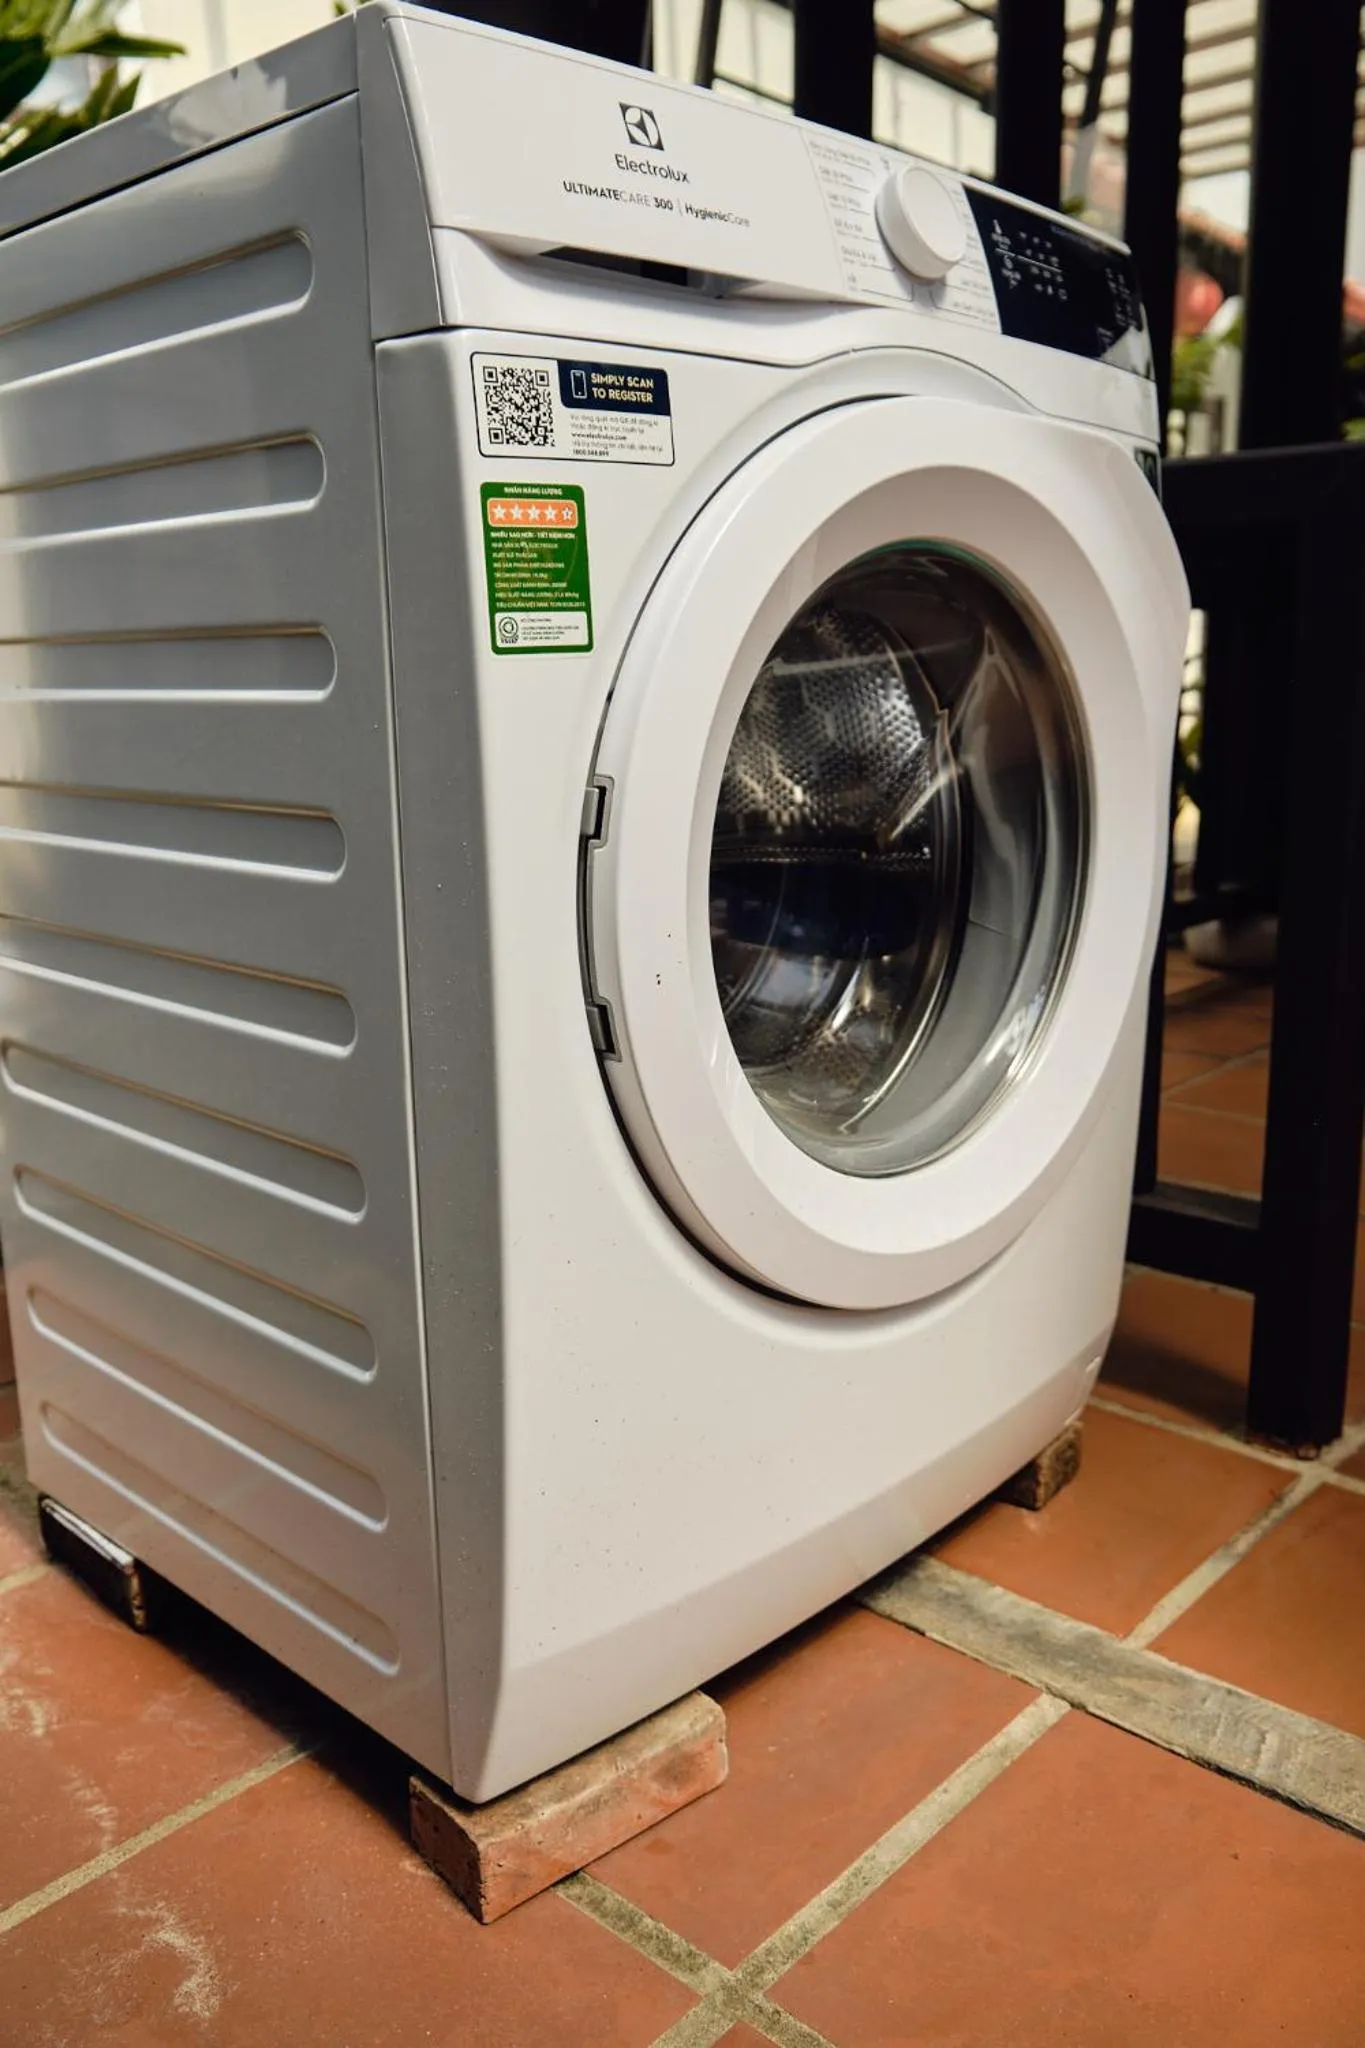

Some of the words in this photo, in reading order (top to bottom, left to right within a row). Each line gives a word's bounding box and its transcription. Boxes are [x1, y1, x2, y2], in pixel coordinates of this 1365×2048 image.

[614, 154, 690, 183] Electrolux
[563, 181, 652, 207] ULTIMATECARE
[653, 197, 674, 211] 300
[685, 203, 750, 227] HygienicCare
[591, 373, 624, 386] SIMPLY
[627, 376, 654, 388] SCAN
[592, 387, 606, 399] TO
[608, 389, 653, 403] REGISTER
